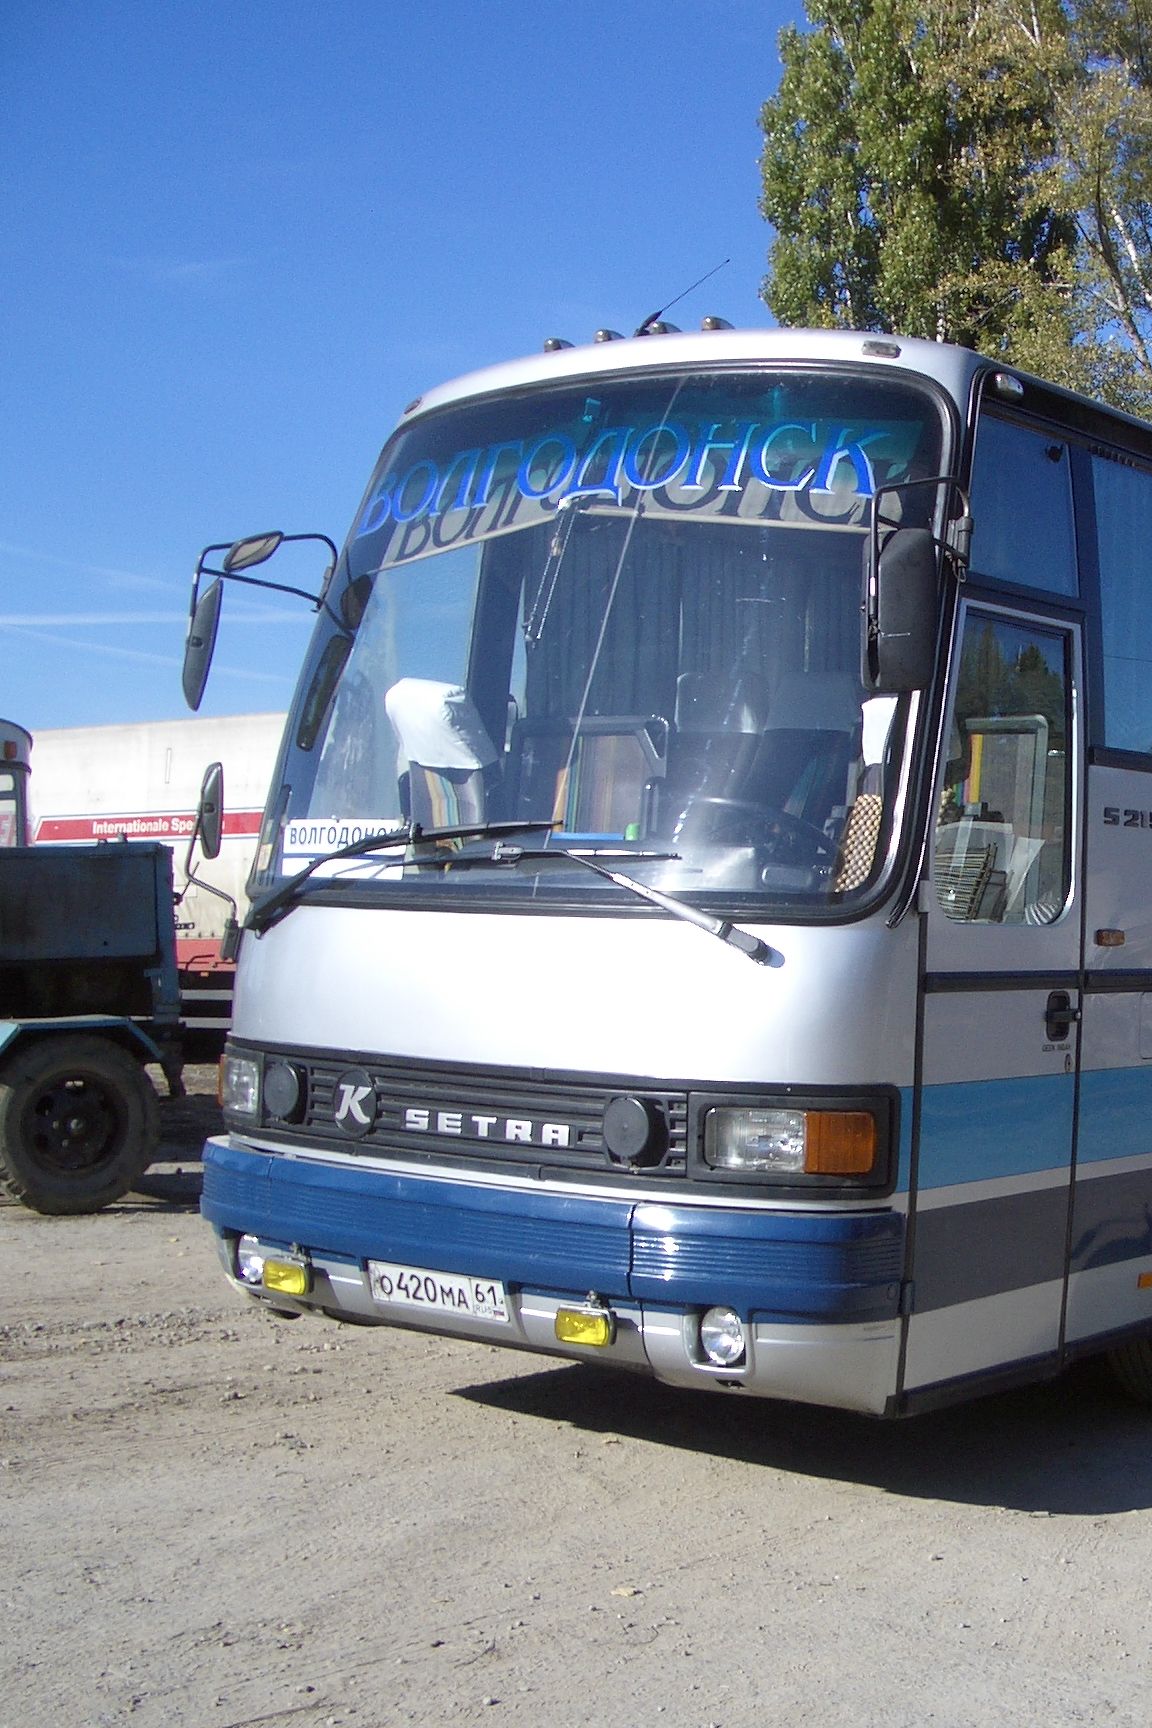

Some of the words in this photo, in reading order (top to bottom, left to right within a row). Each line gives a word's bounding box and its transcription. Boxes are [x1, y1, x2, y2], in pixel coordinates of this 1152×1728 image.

[356, 421, 886, 539] ВОЛГОДОНСК
[92, 818, 169, 834] Internationale
[405, 1108, 570, 1147] SETRA
[474, 1283, 497, 1306] 61
